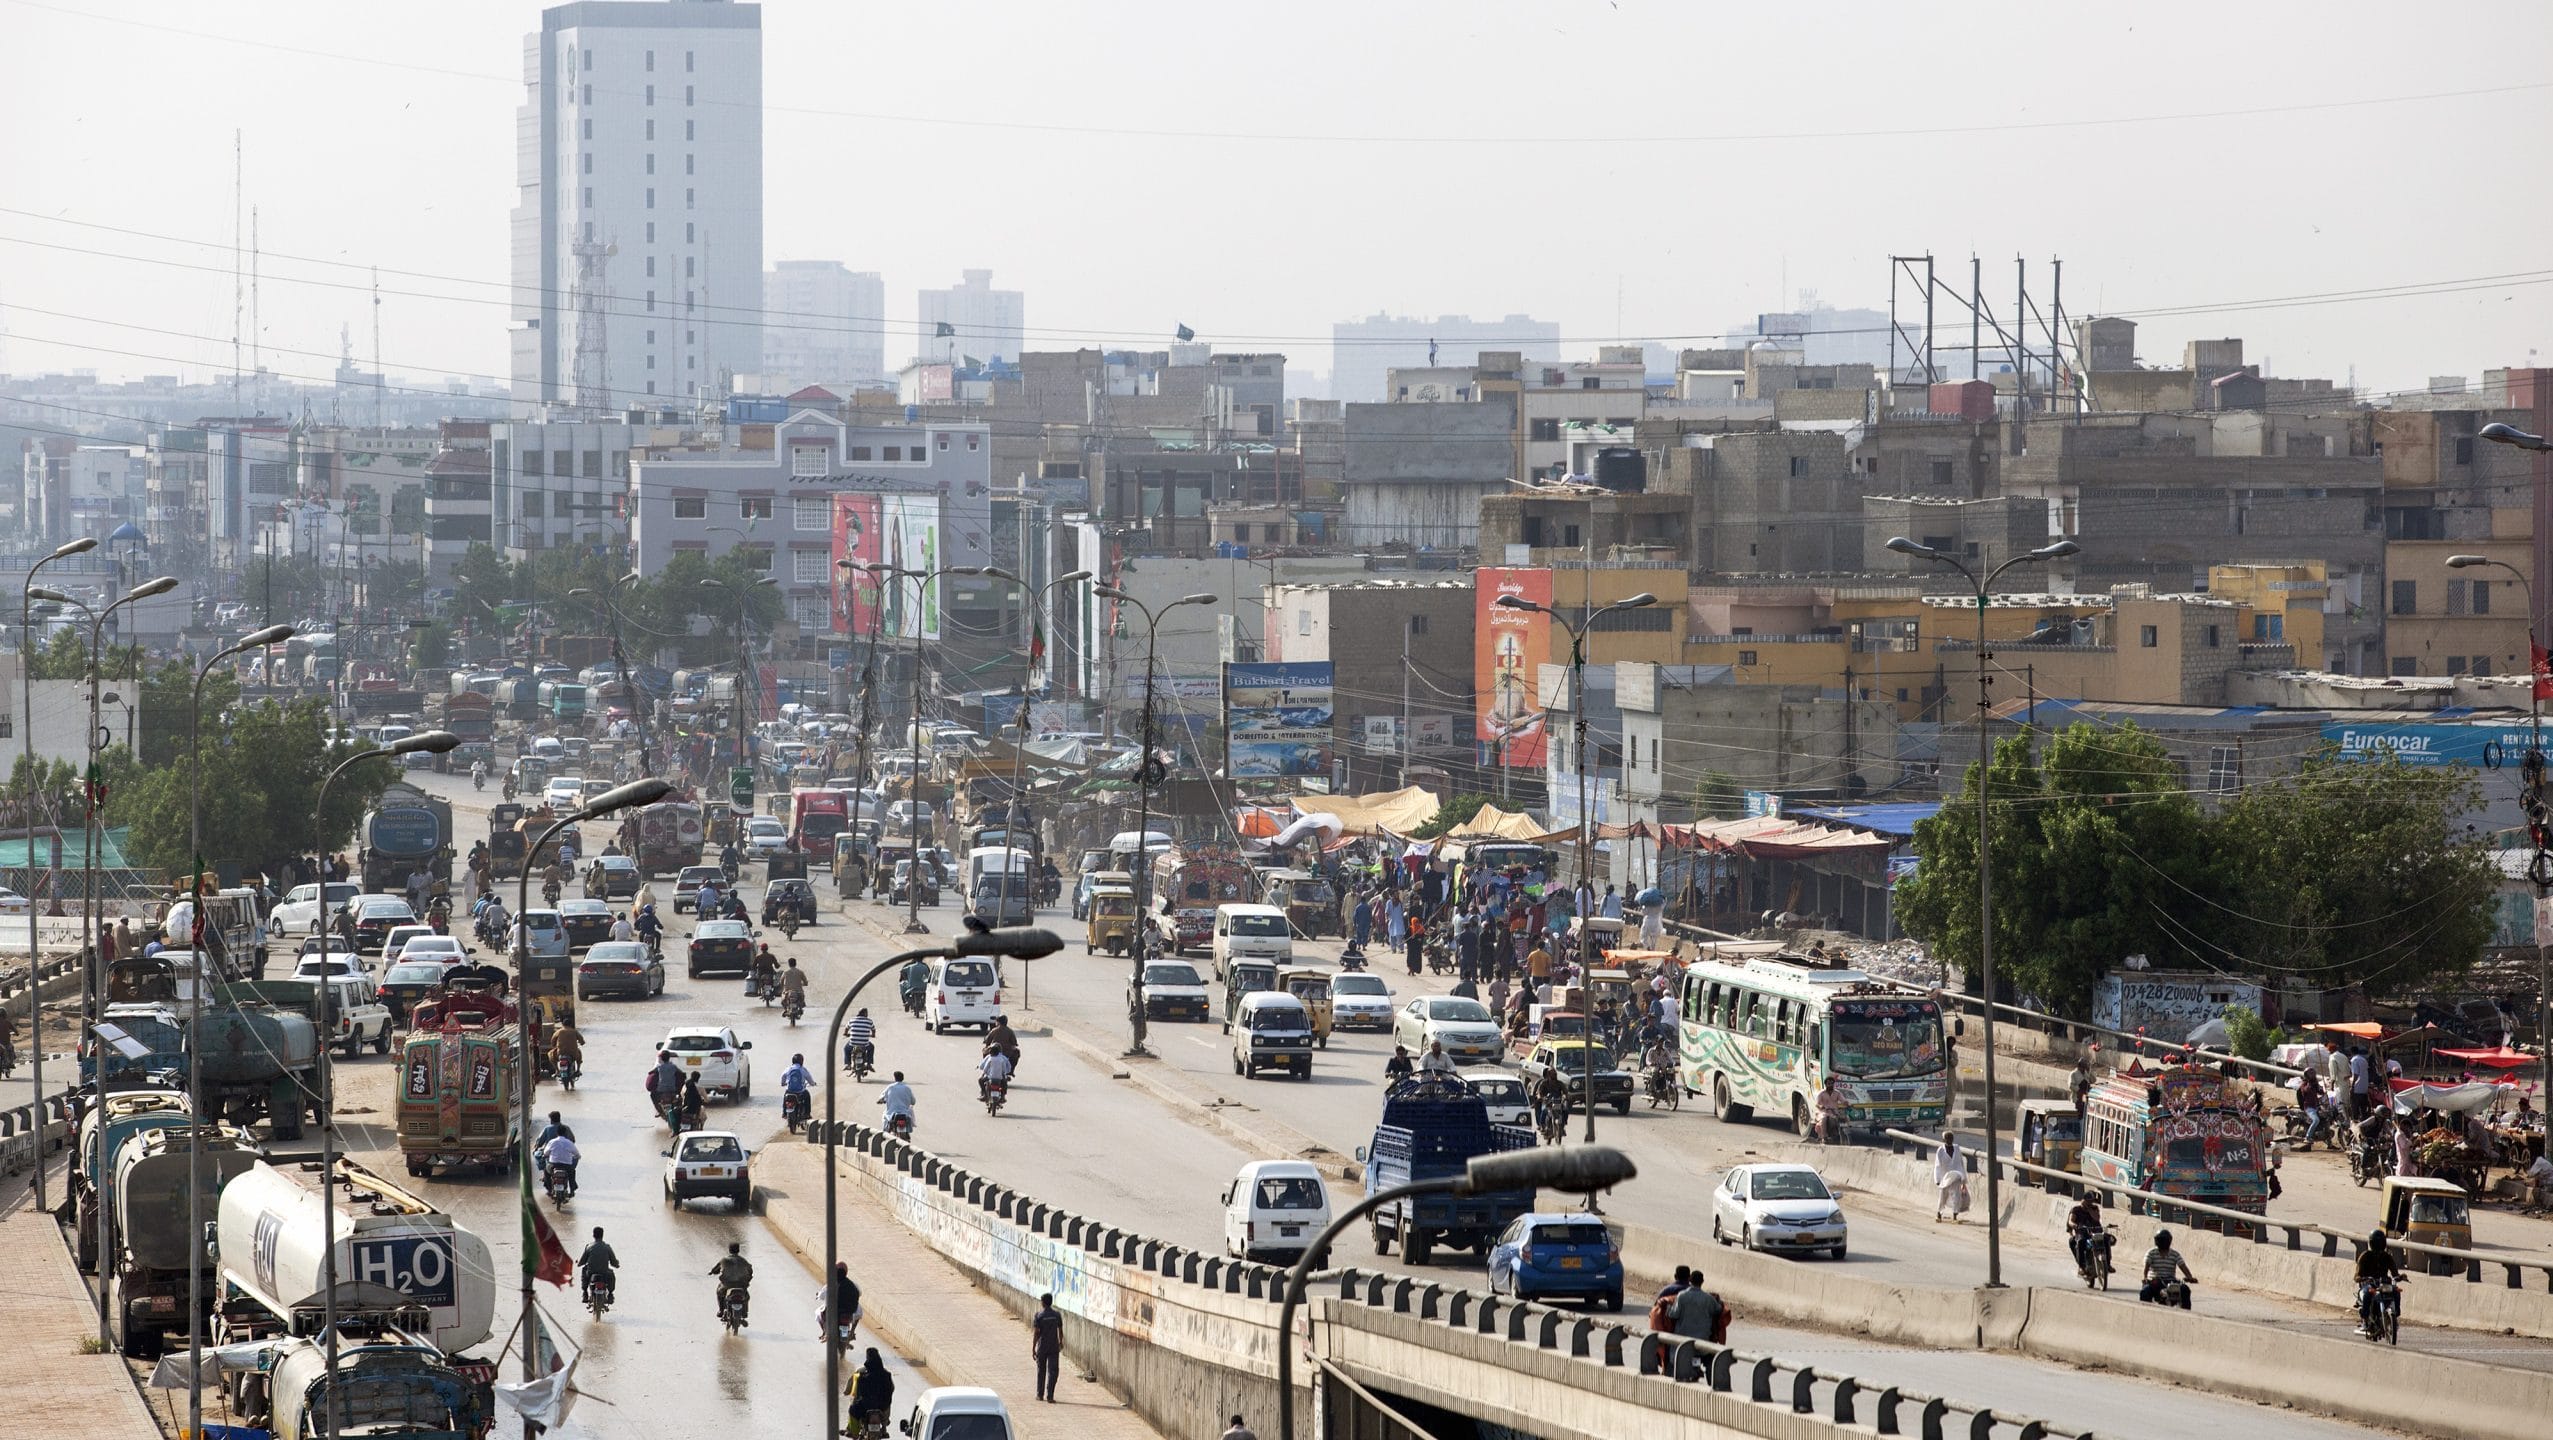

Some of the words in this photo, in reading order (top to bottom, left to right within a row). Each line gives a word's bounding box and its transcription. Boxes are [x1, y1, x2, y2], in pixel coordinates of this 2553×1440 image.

[1233, 676, 1285, 688] Bukhari
[1288, 675, 1330, 687] Travel
[2341, 731, 2432, 751] Europcar
